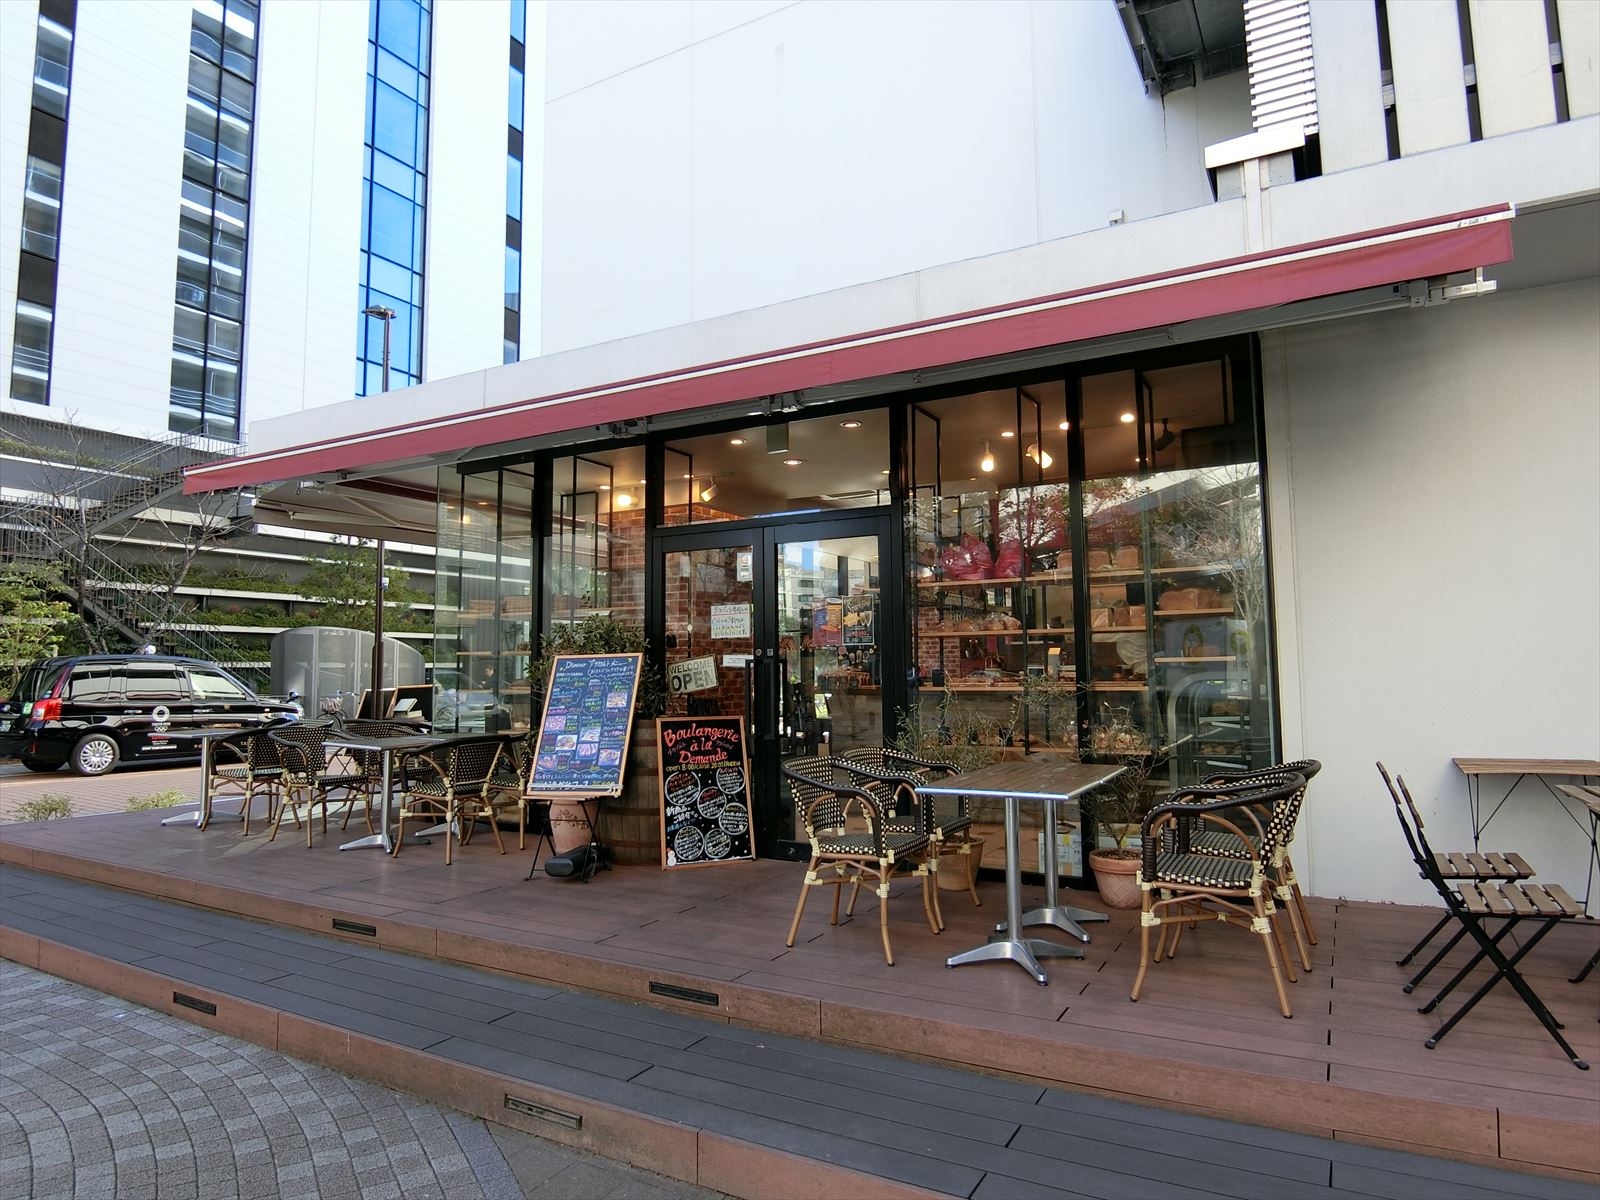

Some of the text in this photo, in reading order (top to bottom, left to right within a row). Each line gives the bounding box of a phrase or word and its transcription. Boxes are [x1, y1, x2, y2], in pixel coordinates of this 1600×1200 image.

[669, 659, 713, 674] WELCOME
[671, 670, 715, 692] OPEN
[664, 722, 739, 748] Boulangerie
[690, 739, 699, 752] à
[702, 738, 713, 750] la
[679, 748, 728, 764] Demande
